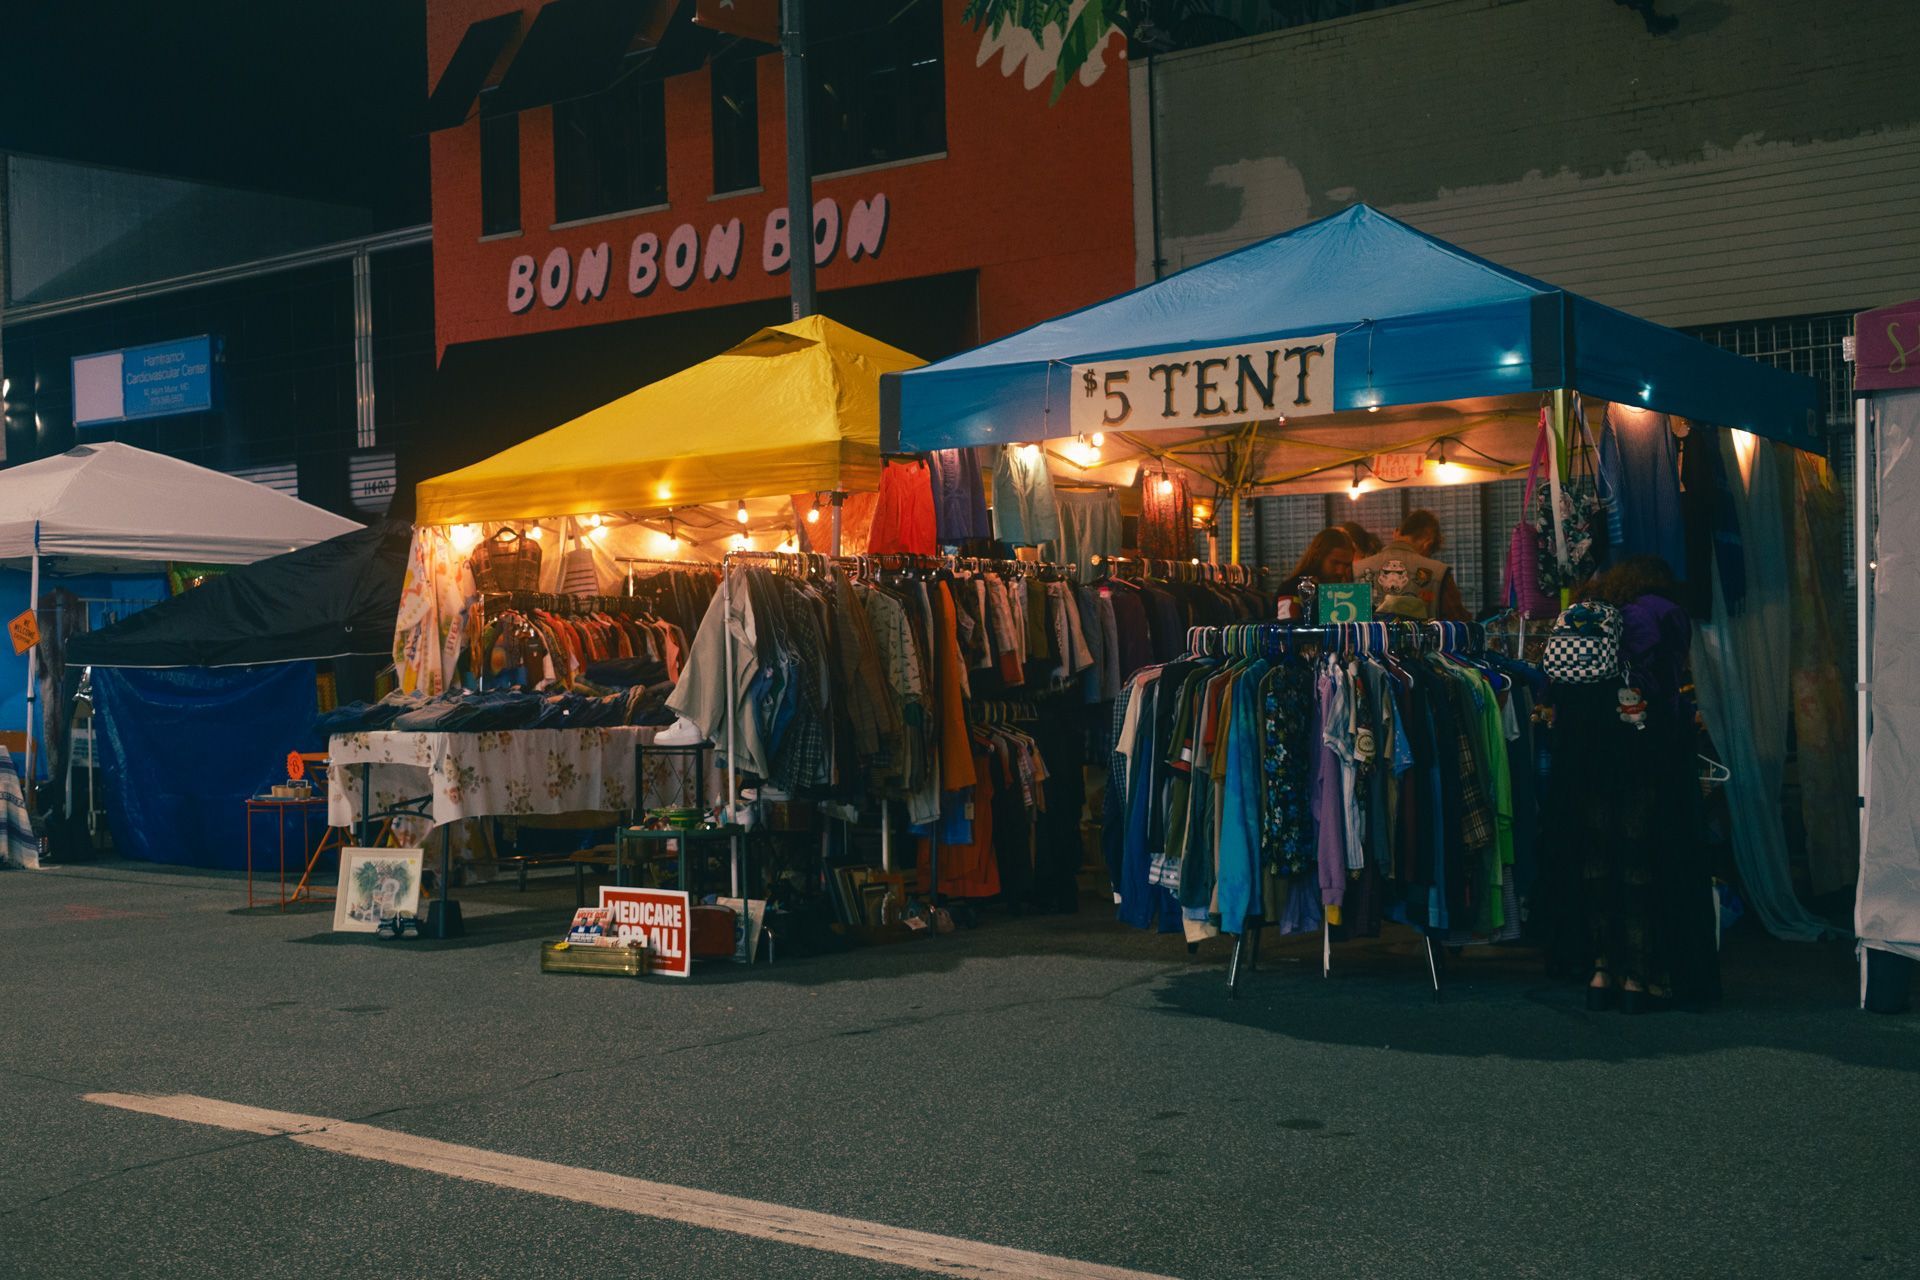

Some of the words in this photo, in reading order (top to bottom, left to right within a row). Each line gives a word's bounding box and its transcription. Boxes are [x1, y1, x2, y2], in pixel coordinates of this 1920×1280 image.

[507, 242, 611, 313] BON
[628, 217, 743, 296] BON
[762, 192, 890, 275] BON
[182, 363, 208, 377] Center
[1083, 368, 1132, 427] $5
[1149, 344, 1325, 418] TENT
[1386, 453, 1408, 466] PAY
[607, 900, 683, 928] MEDICARE
[650, 927, 683, 959] ALL
